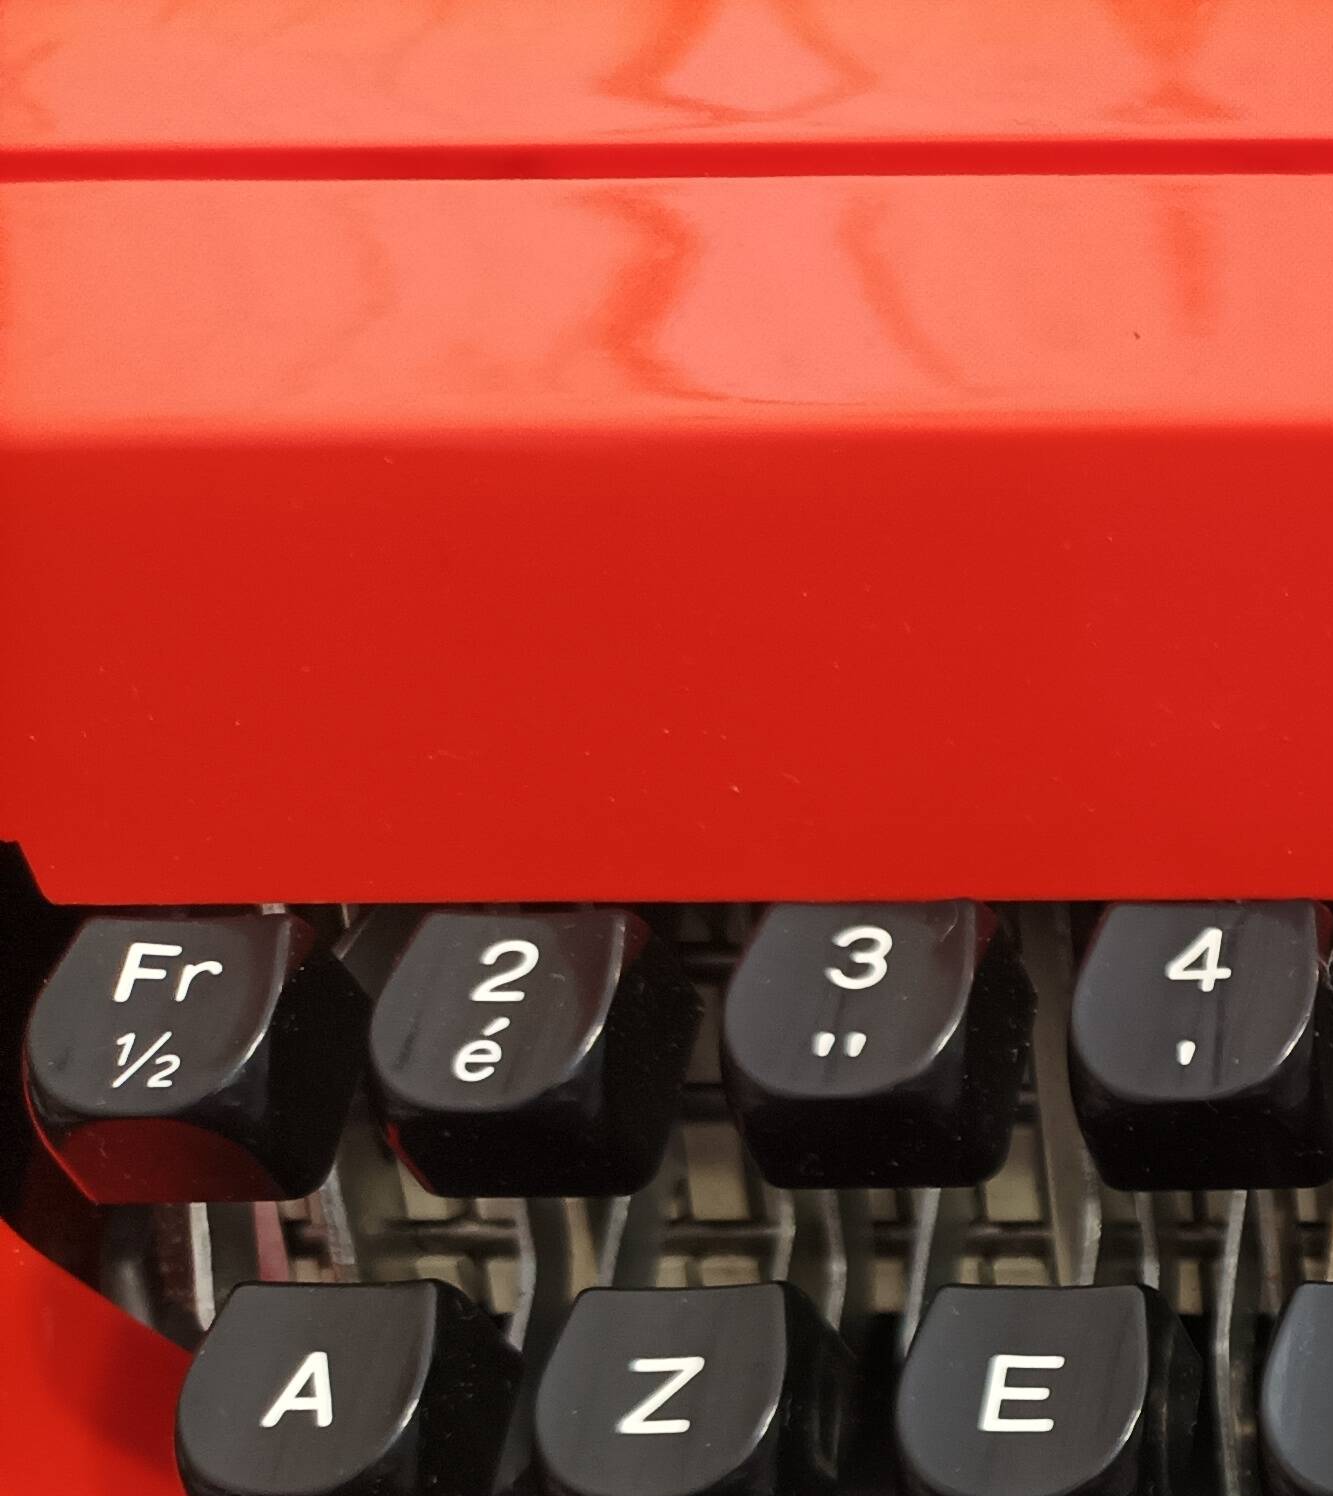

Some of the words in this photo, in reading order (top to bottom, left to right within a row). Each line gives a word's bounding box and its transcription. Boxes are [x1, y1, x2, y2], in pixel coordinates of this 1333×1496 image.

[112, 941, 224, 1004] Fr
[470, 938, 540, 1003] 2
[826, 925, 894, 991] 3
[1165, 926, 1233, 993] 4
[452, 1016, 511, 1083] é
[259, 1350, 334, 1429] A
[616, 1355, 706, 1435] Z
[978, 1353, 1066, 1433] E
